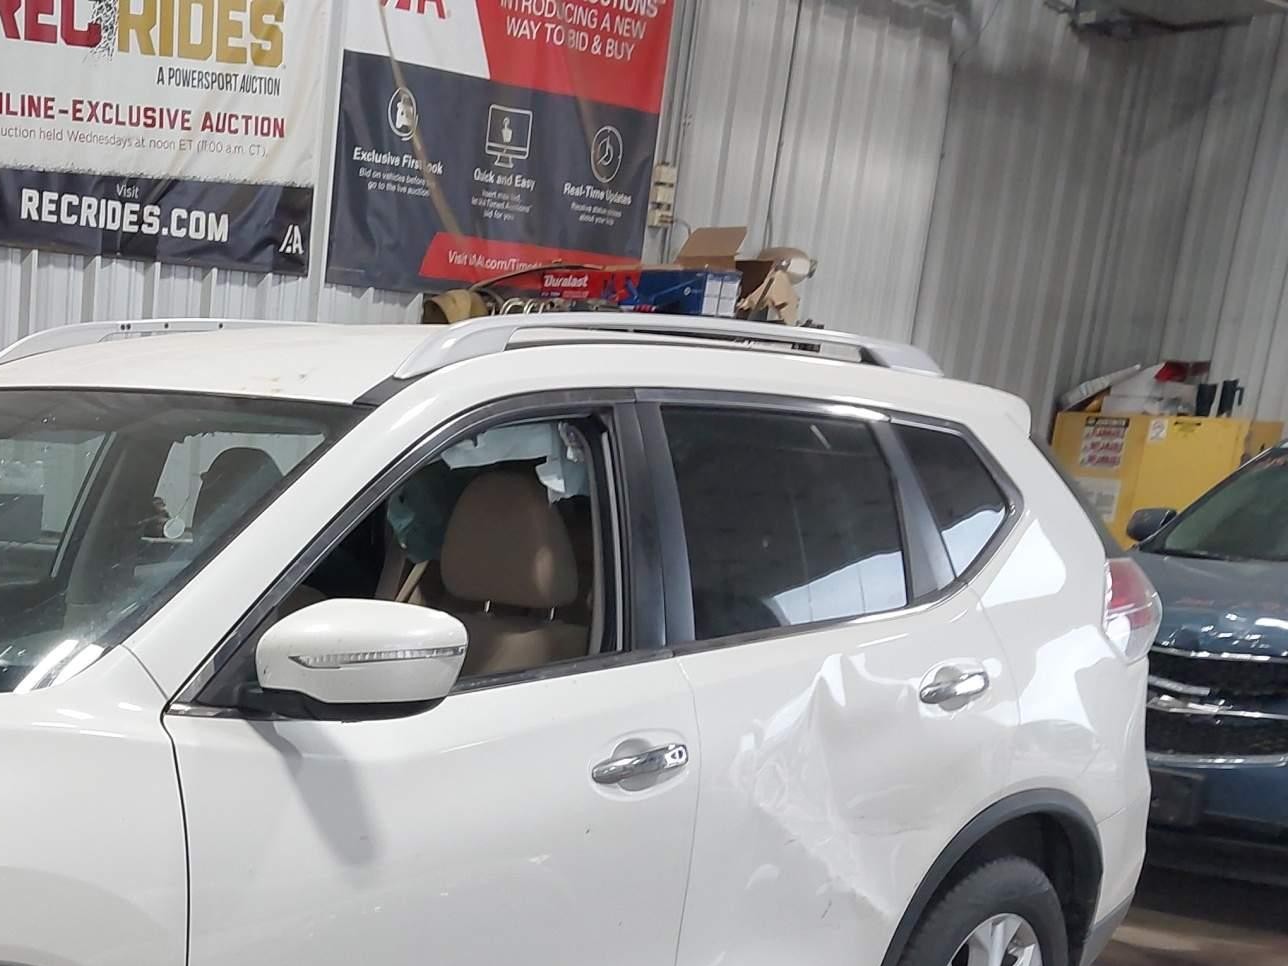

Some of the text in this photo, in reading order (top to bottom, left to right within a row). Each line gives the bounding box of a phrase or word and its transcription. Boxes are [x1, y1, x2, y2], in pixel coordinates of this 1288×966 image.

[118, 0, 285, 68] RIDES
[600, 12, 610, 32] A
[613, 15, 647, 39] NEW
[506, 15, 635, 61] WAY TO BID & BUY
[156, 66, 280, 96] A POWERSPORT AUCTION
[200, 111, 285, 138] AUCTION
[39, 127, 63, 141] held
[67, 130, 133, 150] Wednesdays
[135, 136, 145, 148] at
[149, 139, 175, 150] noon
[179, 139, 193, 151] ET
[353, 147, 400, 166] Exclusive
[116, 183, 140, 198] Visit
[473, 167, 536, 191] Quick and Easy
[563, 182, 605, 201] Real-Time
[20, 188, 229, 242] RECRIDES.COM
[448, 250, 467, 266] Visit
[543, 273, 589, 289] Duralast
